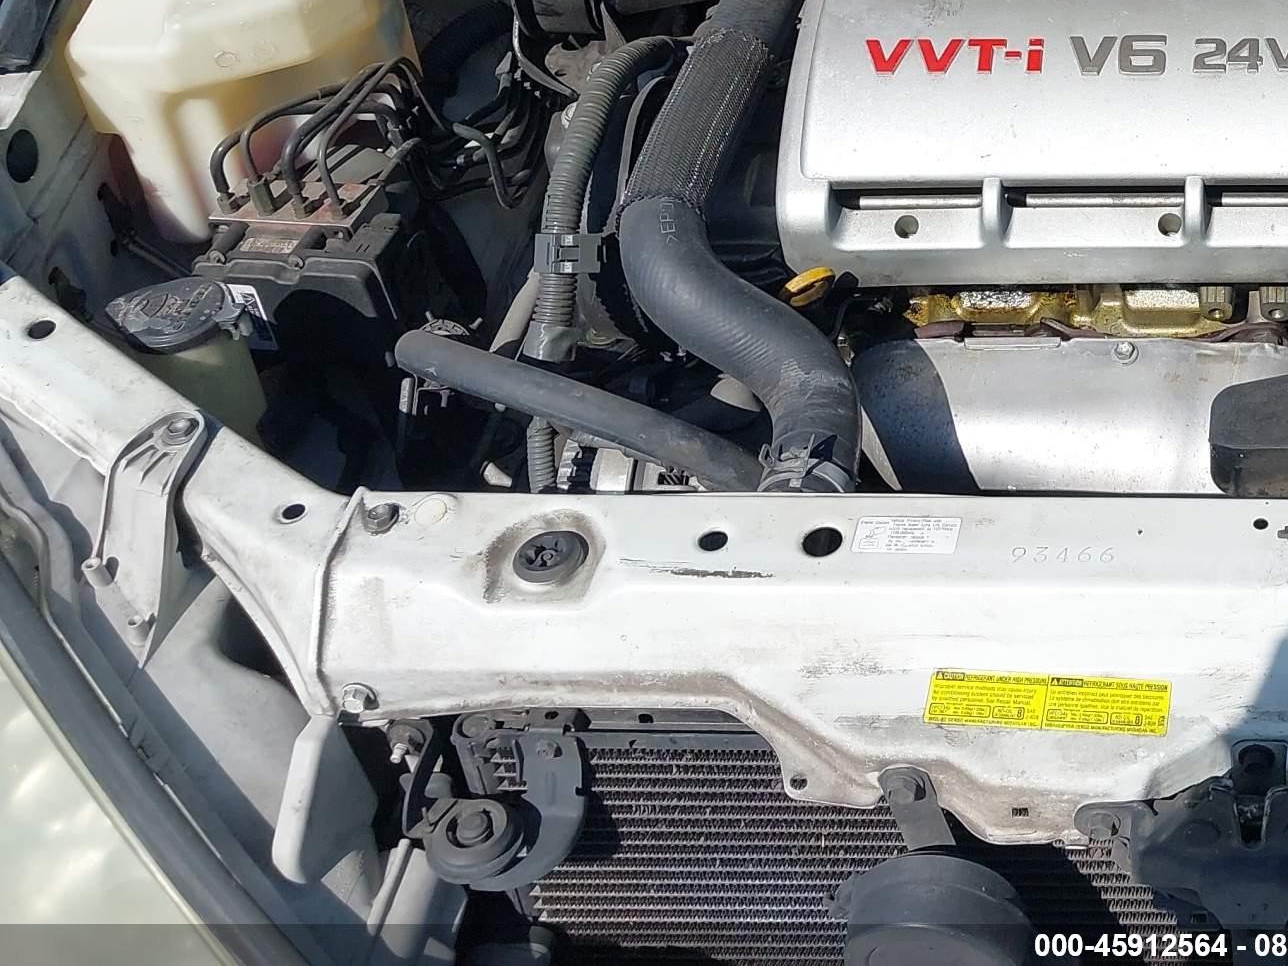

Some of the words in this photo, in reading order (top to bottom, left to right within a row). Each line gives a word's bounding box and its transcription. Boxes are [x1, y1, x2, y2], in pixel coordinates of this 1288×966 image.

[865, 38, 1045, 75] VVT-i
[1069, 35, 1168, 76] V6
[1016, 709, 1023, 718] 8
[1134, 715, 1140, 725] 8
